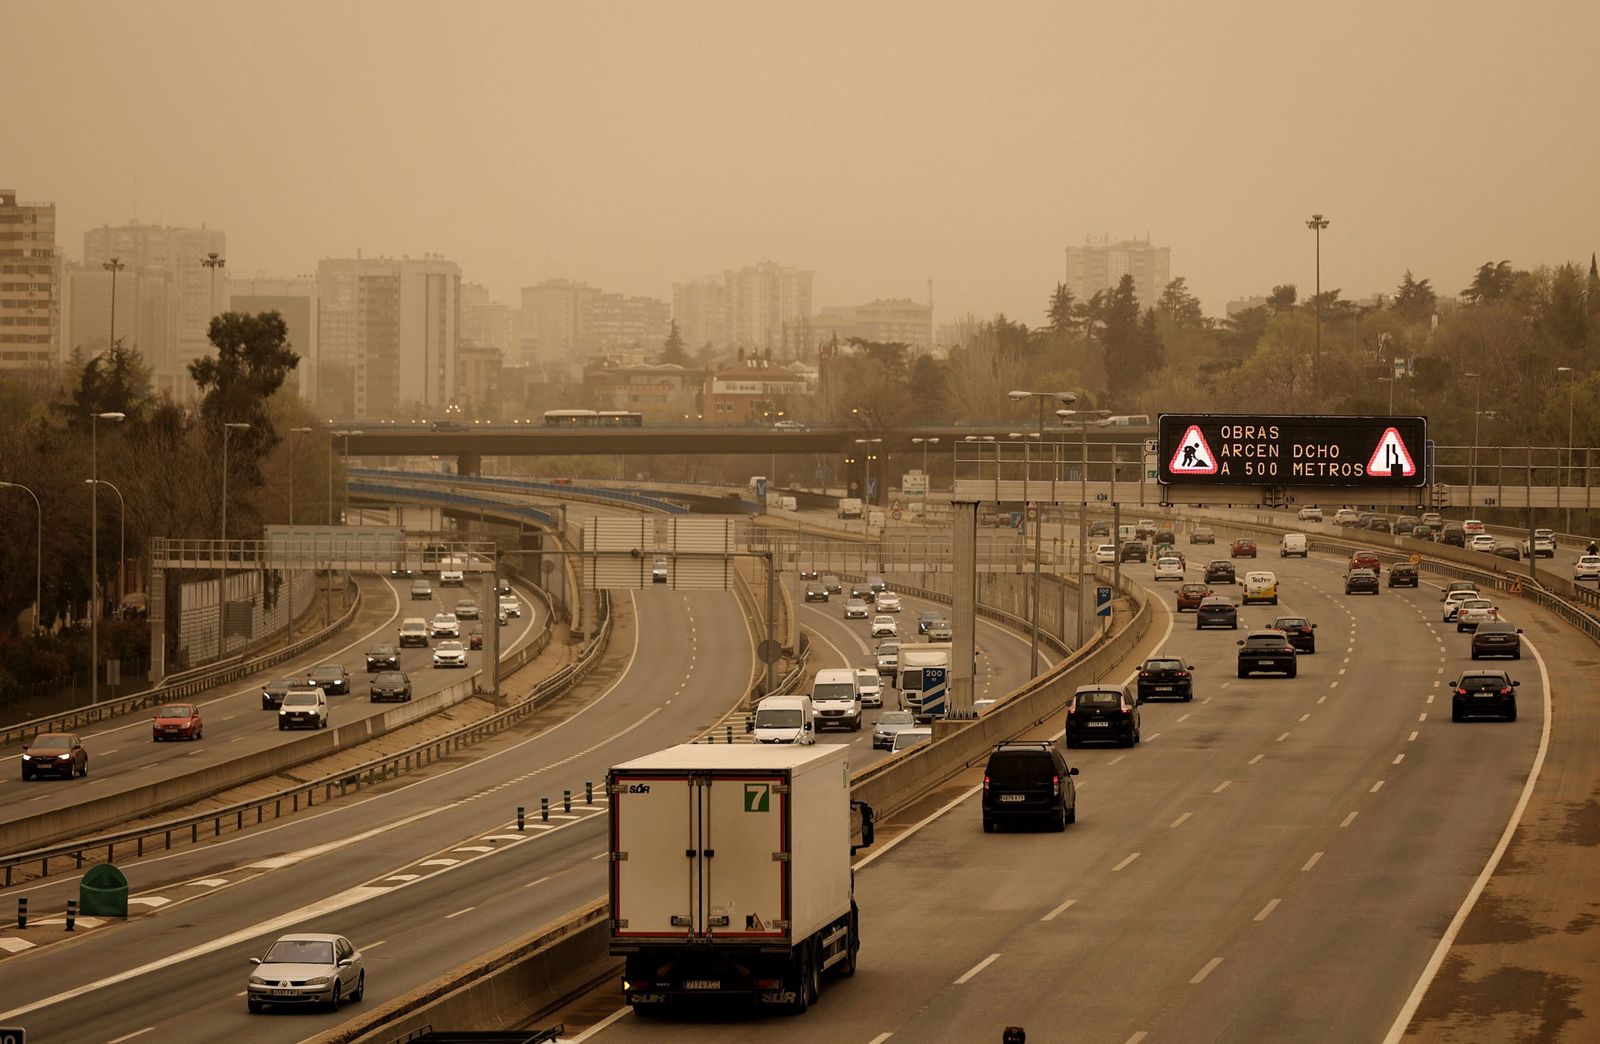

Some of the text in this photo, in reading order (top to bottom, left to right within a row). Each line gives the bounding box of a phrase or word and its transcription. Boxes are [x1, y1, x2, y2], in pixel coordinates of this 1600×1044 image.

[1221, 425, 1279, 439] OBRAS
[1220, 443, 1340, 458] ARCEN DCHO
[1220, 461, 1364, 477] A 500 METROS
[926, 669, 943, 677] 200
[746, 786, 767, 810] 7
